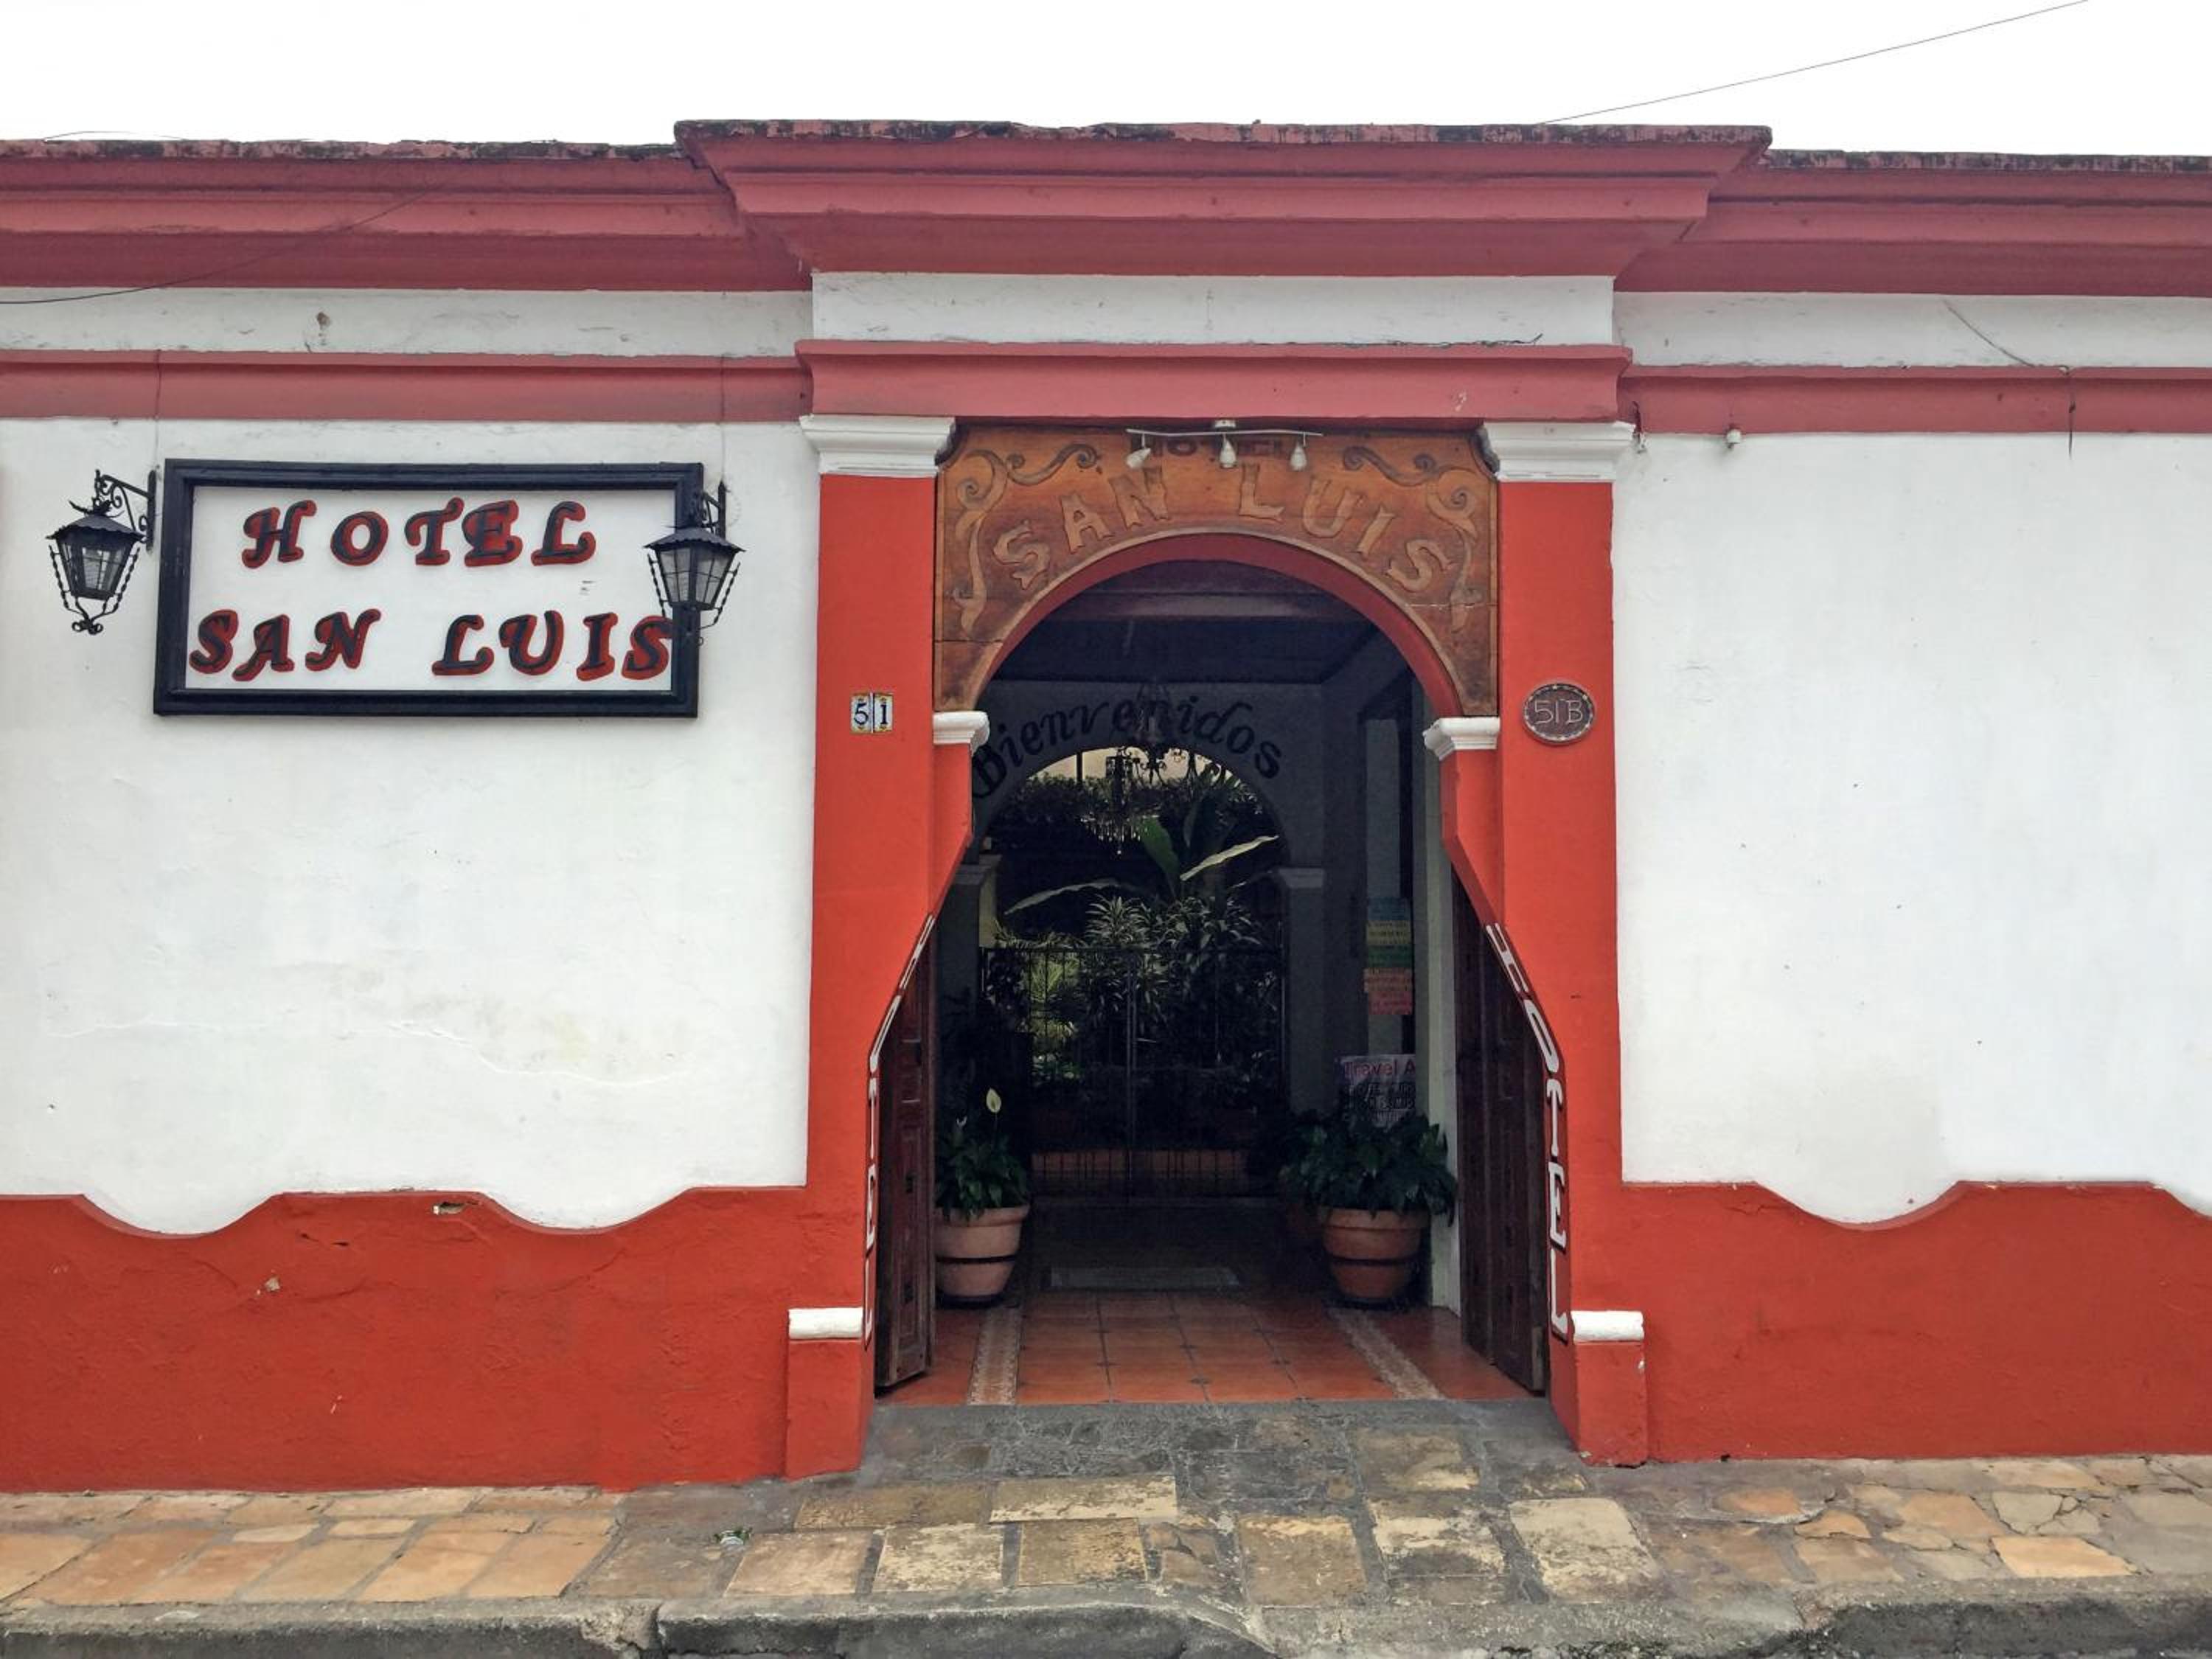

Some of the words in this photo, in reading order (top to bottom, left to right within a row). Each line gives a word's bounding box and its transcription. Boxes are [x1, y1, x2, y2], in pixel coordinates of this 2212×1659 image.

[241, 497, 597, 568] HOTEL
[993, 465, 1172, 591] SAN
[1239, 463, 1455, 591] LUIS
[189, 608, 381, 681] SAN
[432, 611, 673, 681] LUIS
[853, 703, 888, 726] 51
[970, 695, 1281, 799] Bienvenidos
[1534, 698, 1584, 725] 51B
[1486, 922, 1568, 1342] HOTEL
